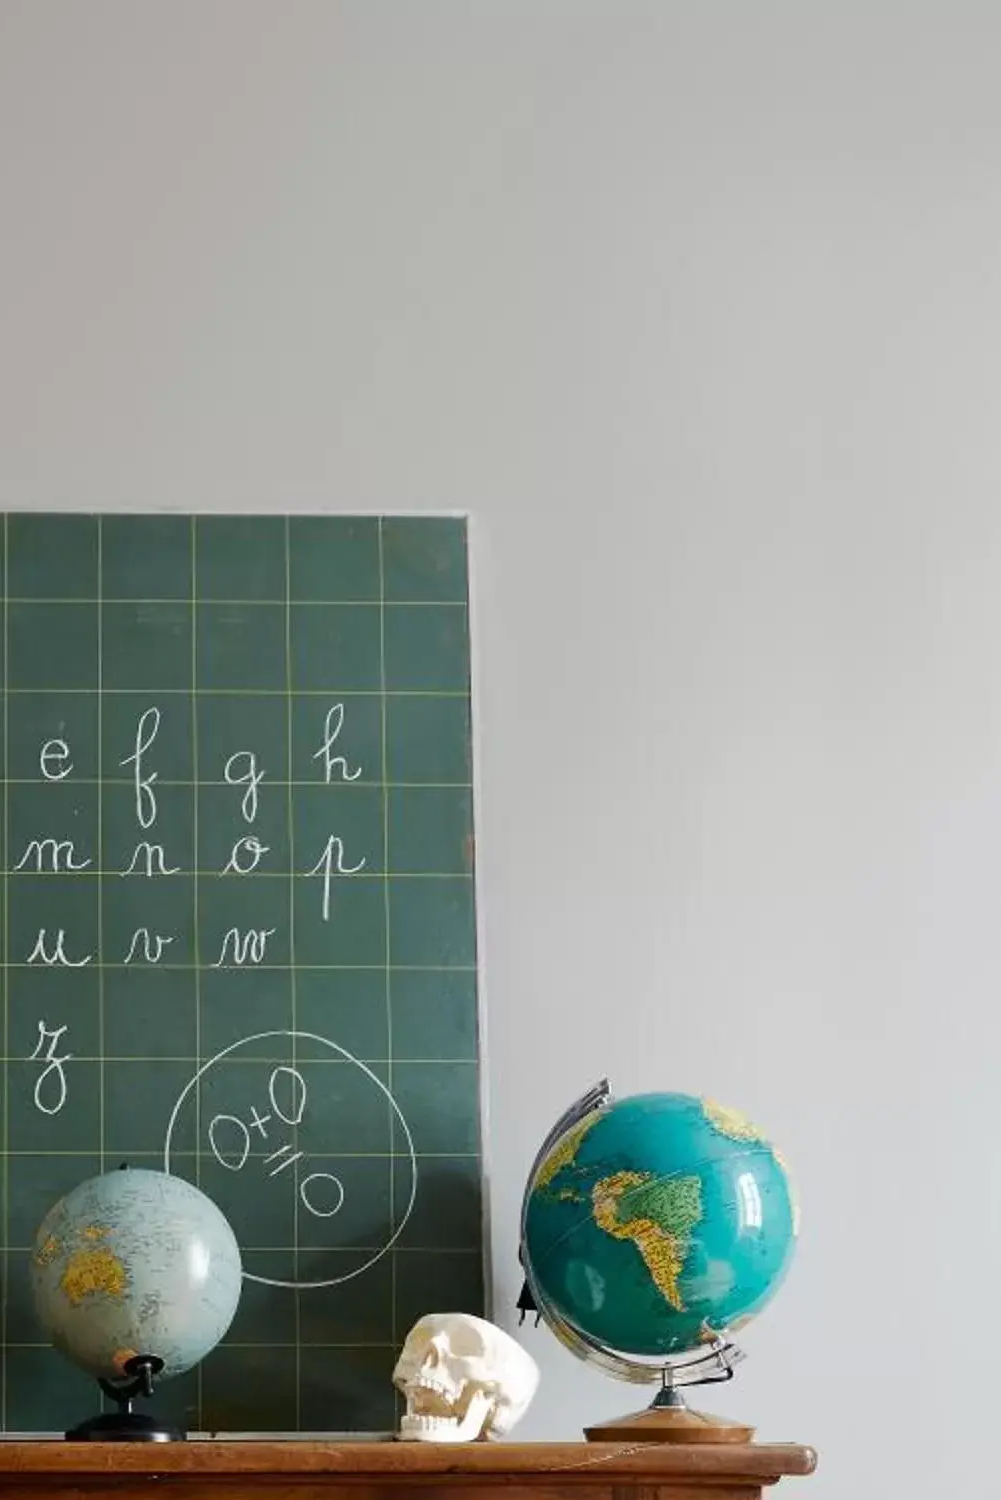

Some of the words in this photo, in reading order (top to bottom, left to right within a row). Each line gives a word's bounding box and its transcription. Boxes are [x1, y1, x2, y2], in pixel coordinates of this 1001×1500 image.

[40, 739, 74, 780] e
[120, 707, 160, 828] f
[225, 751, 265, 822] g
[314, 703, 361, 783] h
[15, 838, 92, 873] m
[120, 841, 180, 877] n
[220, 836, 270, 877] o
[305, 835, 366, 921] p
[27, 929, 92, 967] u
[124, 928, 173, 964] v
[211, 927, 277, 967] w
[29, 1020, 73, 1115] z
